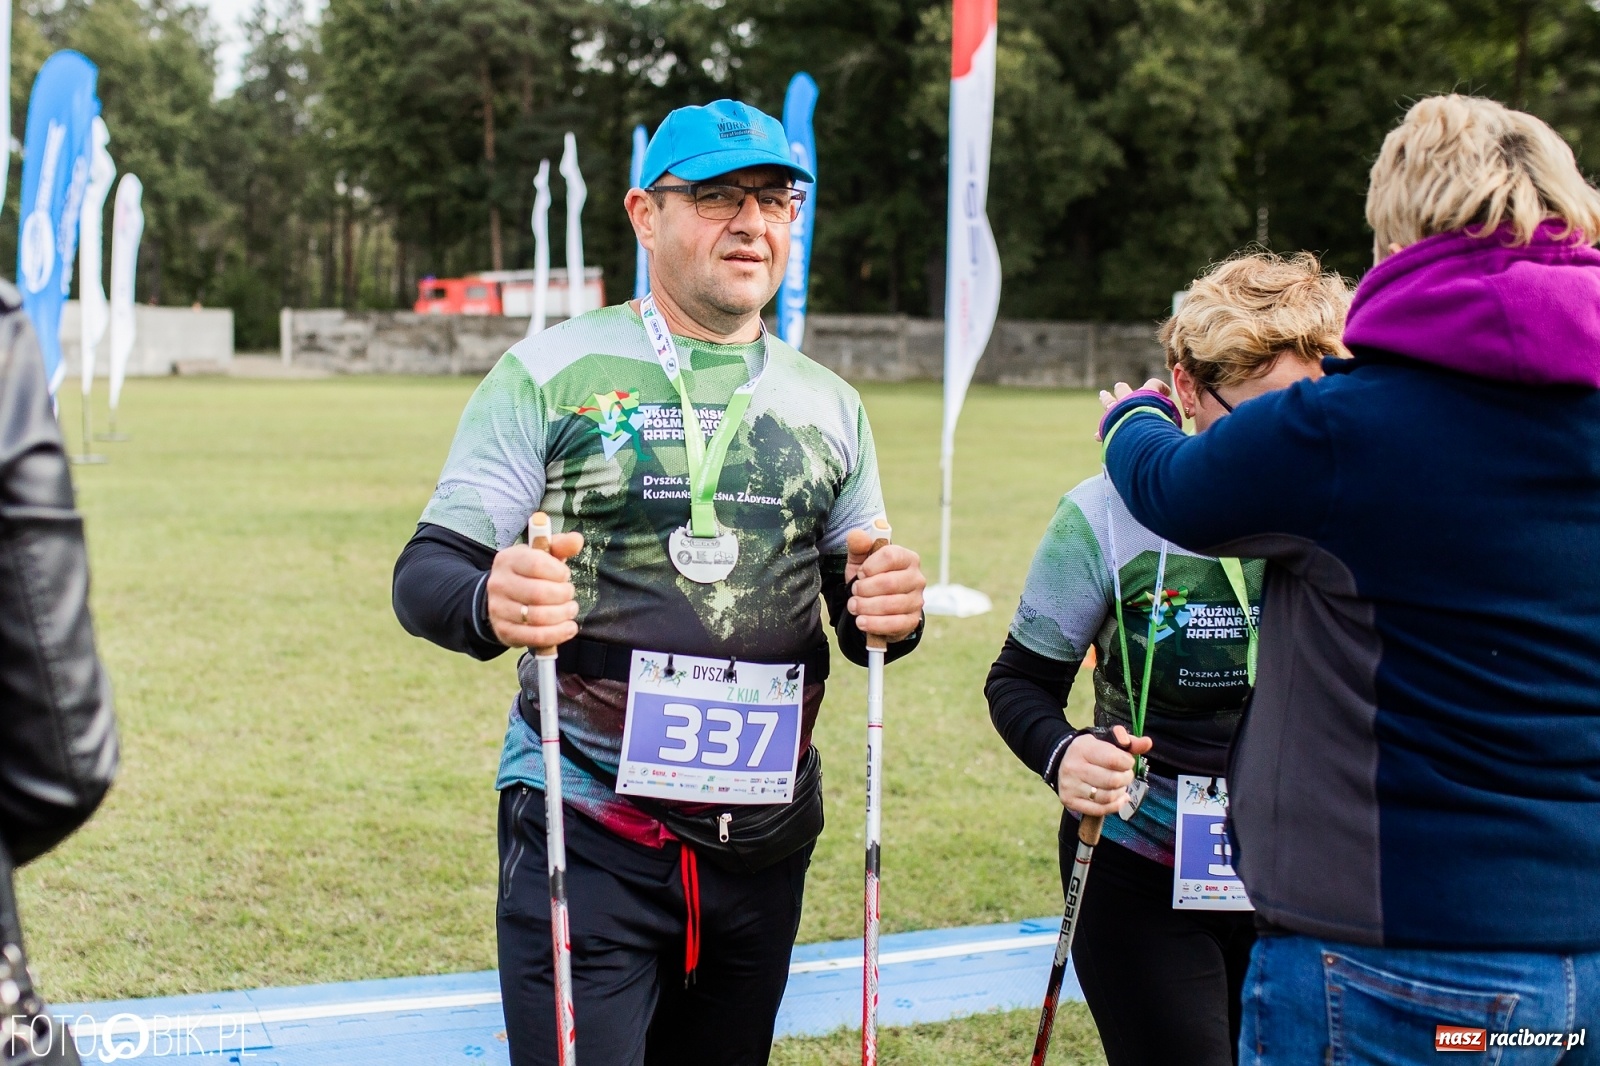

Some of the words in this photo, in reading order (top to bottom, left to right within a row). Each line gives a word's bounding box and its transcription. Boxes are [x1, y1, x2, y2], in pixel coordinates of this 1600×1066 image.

[717, 121, 745, 132] WORK
[736, 492, 783, 506] ZADYSZKA
[1179, 668, 1220, 678] DYSZKA
[1232, 669, 1248, 677] KIJ
[727, 686, 735, 701] Z
[737, 687, 759, 703] KIJA
[658, 703, 779, 768] 337
[1062, 876, 1081, 937] GABEL
